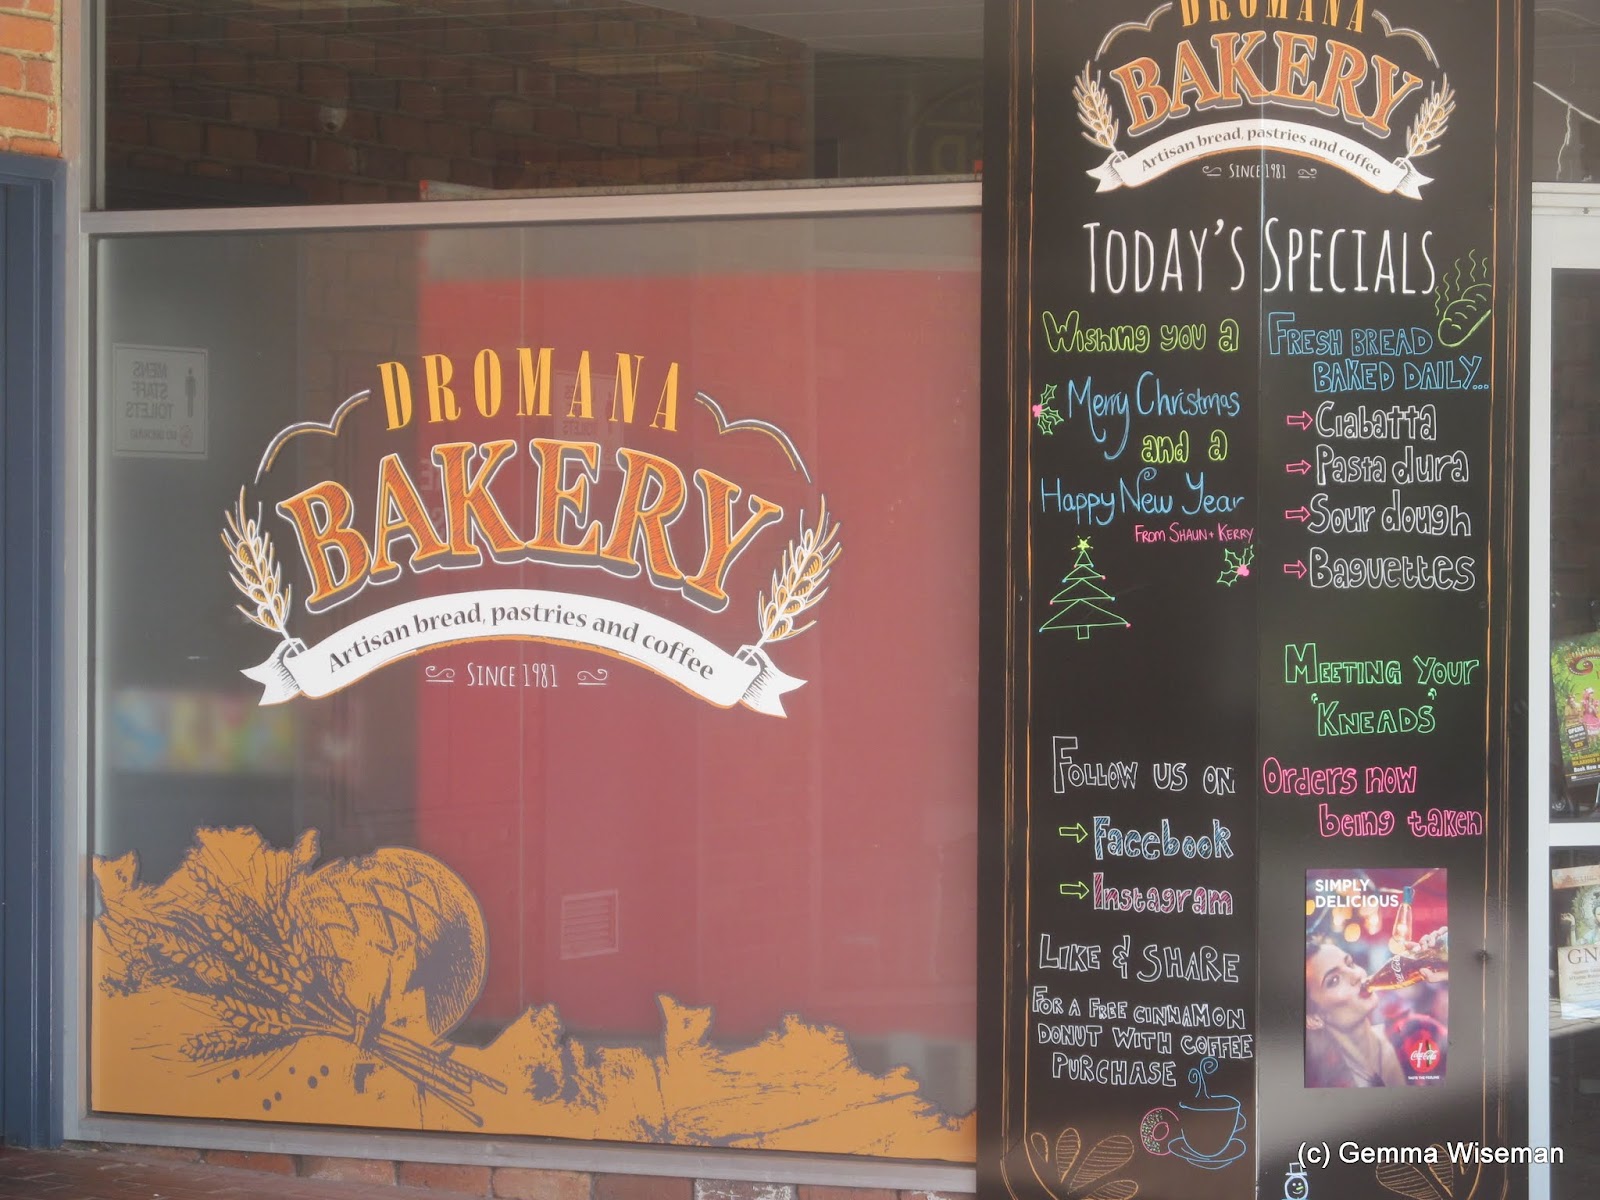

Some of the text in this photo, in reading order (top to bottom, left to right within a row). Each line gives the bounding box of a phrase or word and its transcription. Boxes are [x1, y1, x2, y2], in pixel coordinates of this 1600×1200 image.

[1110, 30, 1423, 139] BAKERY
[1141, 127, 1382, 177] Artisan bread, pastries and coffee
[1265, 163, 1287, 179] 1981
[1082, 216, 1436, 294] TODAY'S SPECIALS
[1042, 310, 1239, 353] Wishing you a
[1268, 311, 1434, 356] FRESH BREAD
[377, 347, 680, 431] DROMANA
[1313, 359, 1395, 393] BAKED
[1067, 370, 1241, 460] Merry Christmas
[1315, 400, 1437, 440] Ciabatta
[1141, 428, 1228, 463] and a
[1316, 443, 1469, 485] Pasta dura
[1040, 466, 1245, 526] Happy New Year
[1307, 489, 1472, 537] Sour dough
[276, 438, 783, 613] BAKERY
[1169, 521, 1208, 543] SHAUN
[1217, 522, 1255, 544] KERRY
[1309, 546, 1476, 592] Baguettes
[326, 602, 715, 680] Artisan bread, pastries and coffee
[522, 662, 559, 688] 1981
[1285, 642, 1402, 685] MEETING
[1052, 735, 1139, 794] FOLLOW
[1262, 756, 1418, 796] Orders now
[1093, 815, 1234, 861] Facebook
[1318, 803, 1484, 838] being taken
[1093, 871, 1233, 916] Instagram
[1315, 878, 1371, 892] SIMPLY
[1315, 894, 1400, 909] DELICIOUS
[1038, 933, 1101, 973] LIKE
[1136, 944, 1240, 983] SHARE
[1567, 946, 1600, 965] GN
[1032, 986, 1246, 1030] FOR A FREE CINNAMON
[1037, 1023, 1254, 1060] DONUT WITH COFFEE
[1052, 1051, 1177, 1087] PURCHASE
